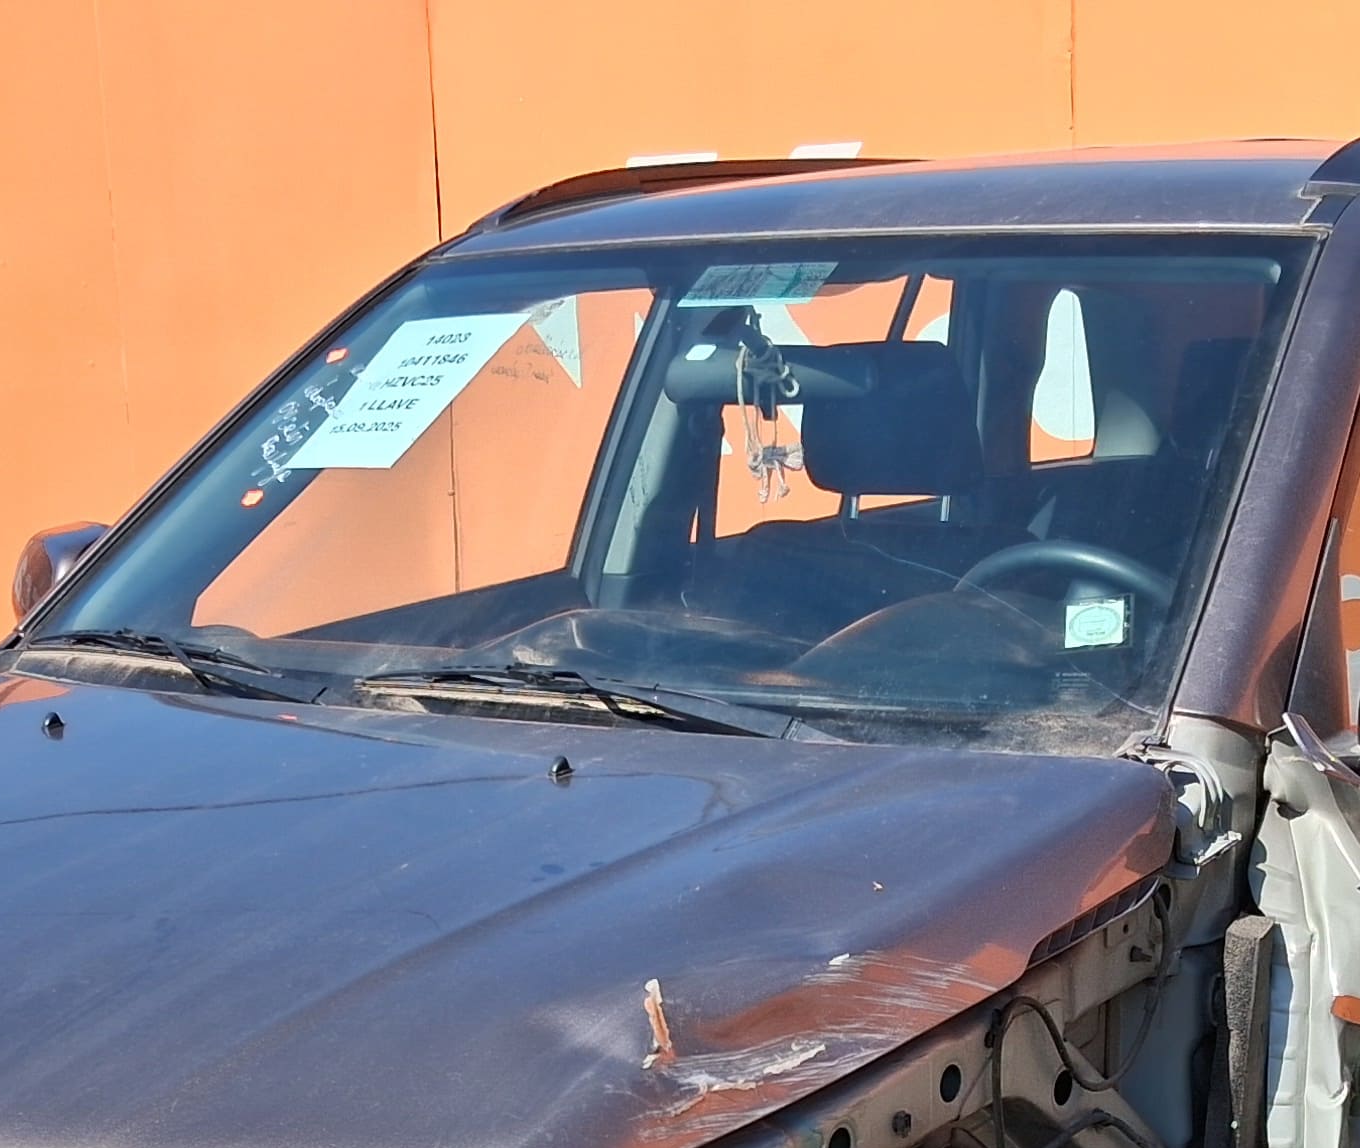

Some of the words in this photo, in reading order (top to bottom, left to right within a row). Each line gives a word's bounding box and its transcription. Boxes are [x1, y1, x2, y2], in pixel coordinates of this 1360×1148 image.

[426, 332, 472, 346] 14023
[381, 375, 444, 389] HZVC25
[368, 398, 420, 411] LLAVE
[330, 422, 402, 434] 15.09.2025
